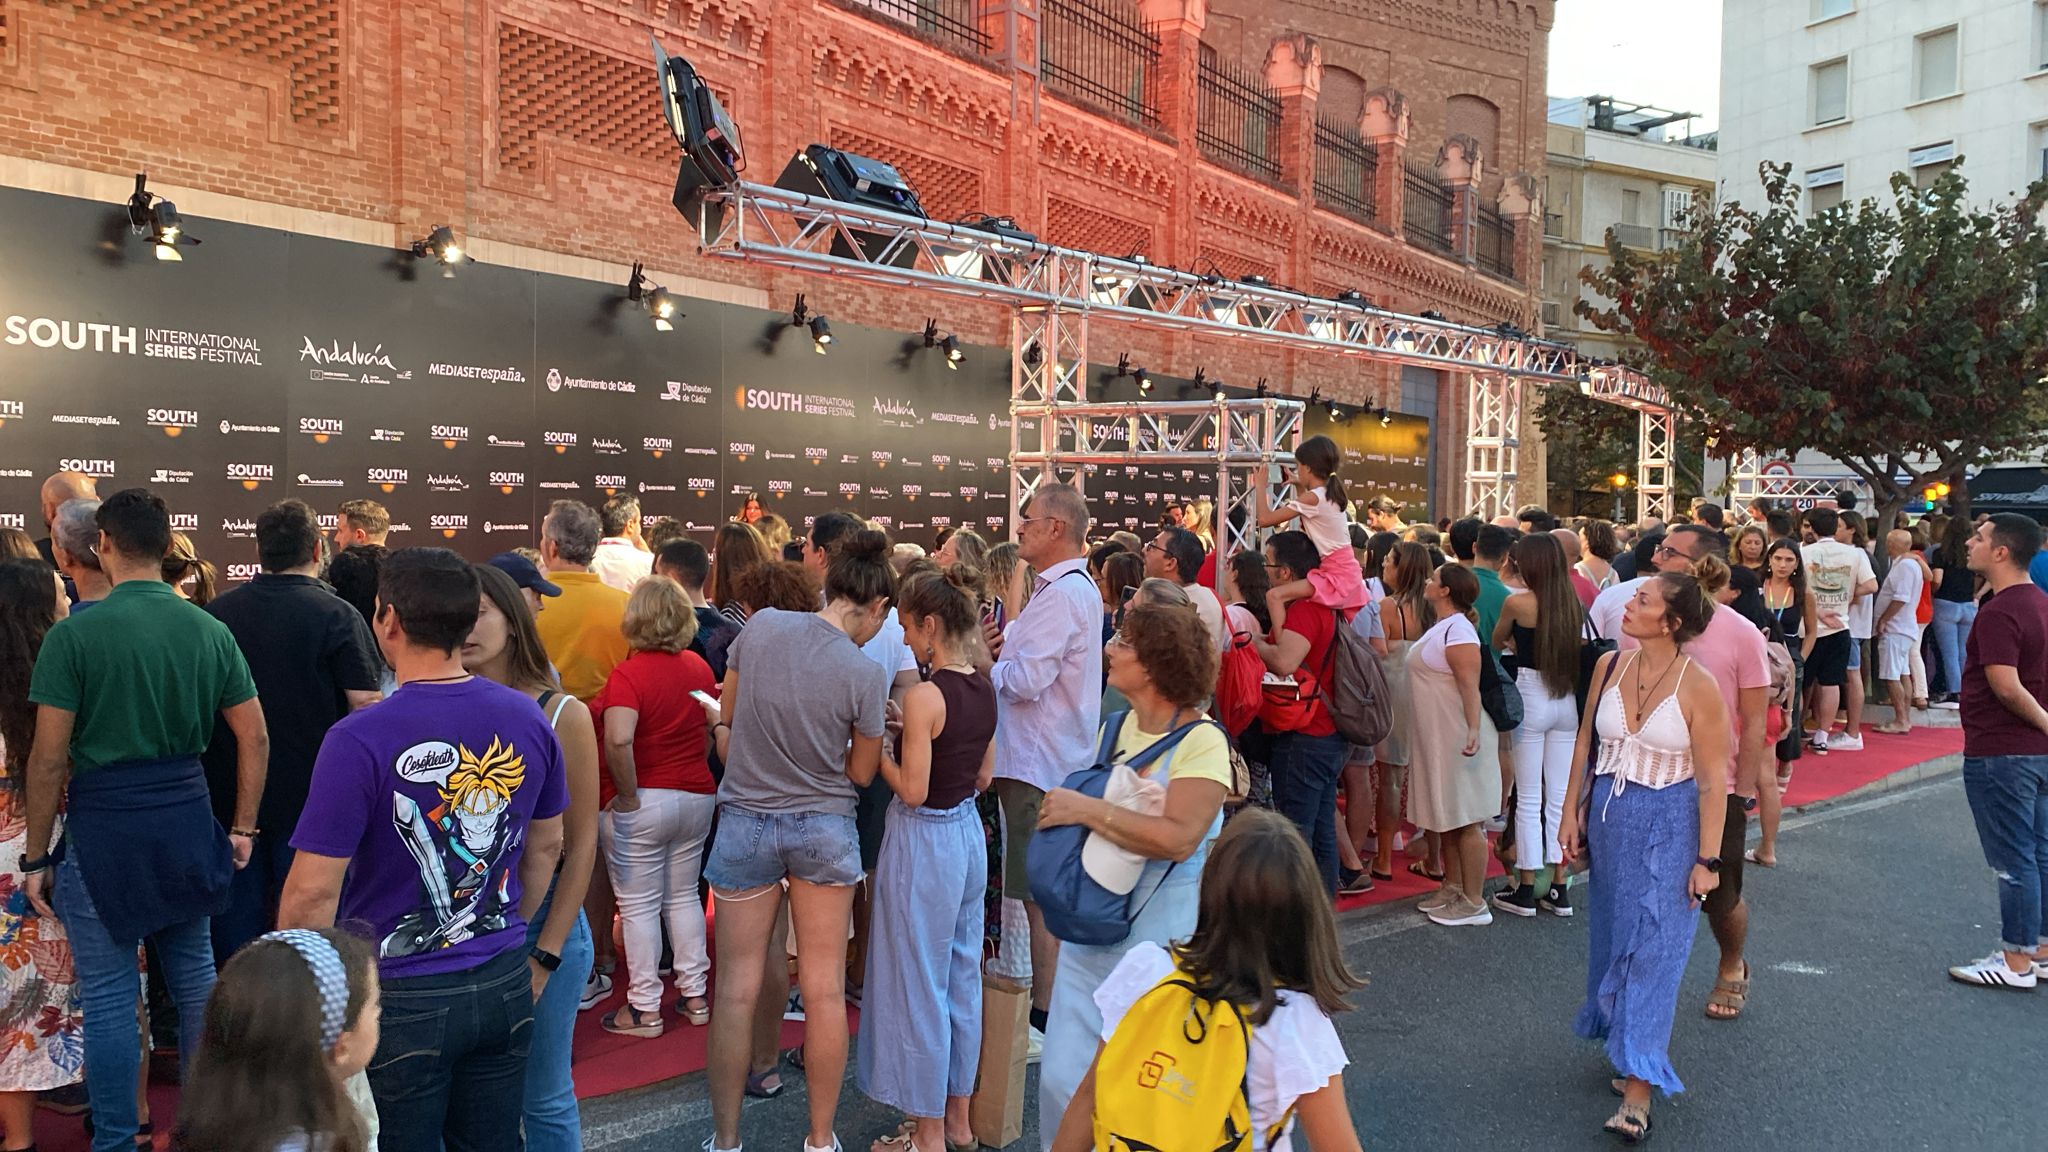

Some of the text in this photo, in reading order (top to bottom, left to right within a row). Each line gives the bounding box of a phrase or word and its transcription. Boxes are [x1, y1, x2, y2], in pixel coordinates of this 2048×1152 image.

[4, 315, 261, 355] SOUTH INTERNATIONAL
[144, 343, 262, 366] SERIES FESTIVAL
[299, 335, 397, 370] Andalucía
[564, 376, 636, 392] Ayuntamiento de Cádiz
[682, 383, 712, 394] Diputación
[682, 394, 707, 404] de Cádiz
[747, 389, 856, 412] SOUTH INTERNATIONAL
[147, 408, 198, 423] SOUTH
[805, 405, 856, 417] SERIES FESTIVAL
[300, 418, 343, 431] SOUTH
[431, 425, 468, 437] SOUTH
[544, 432, 577, 442] SOUTH
[643, 437, 672, 448] SOUTH
[730, 442, 755, 452] SOUTH
[805, 447, 828, 457] SOUTH
[872, 451, 892, 460] SOUTH
[932, 455, 950, 463] SOUTH
[59, 459, 115, 473] SOUTH
[987, 458, 1004, 466] SOUTH
[227, 464, 273, 477] SOUTH
[368, 469, 407, 480] SOUTH
[490, 472, 524, 483] SOUTH
[595, 475, 626, 485] SOUTH
[688, 478, 714, 487] SOUTH
[768, 480, 792, 489] SOUTH
[840, 483, 860, 492] SOUTH
[902, 485, 921, 493] SOUTH
[960, 487, 977, 495] SOUTH
[1799, 499, 1812, 508] 20
[169, 514, 198, 526] UTH
[431, 515, 468, 526] SOUTH
[987, 516, 1003, 524] SOUTH
[227, 563, 262, 576] SOUT
